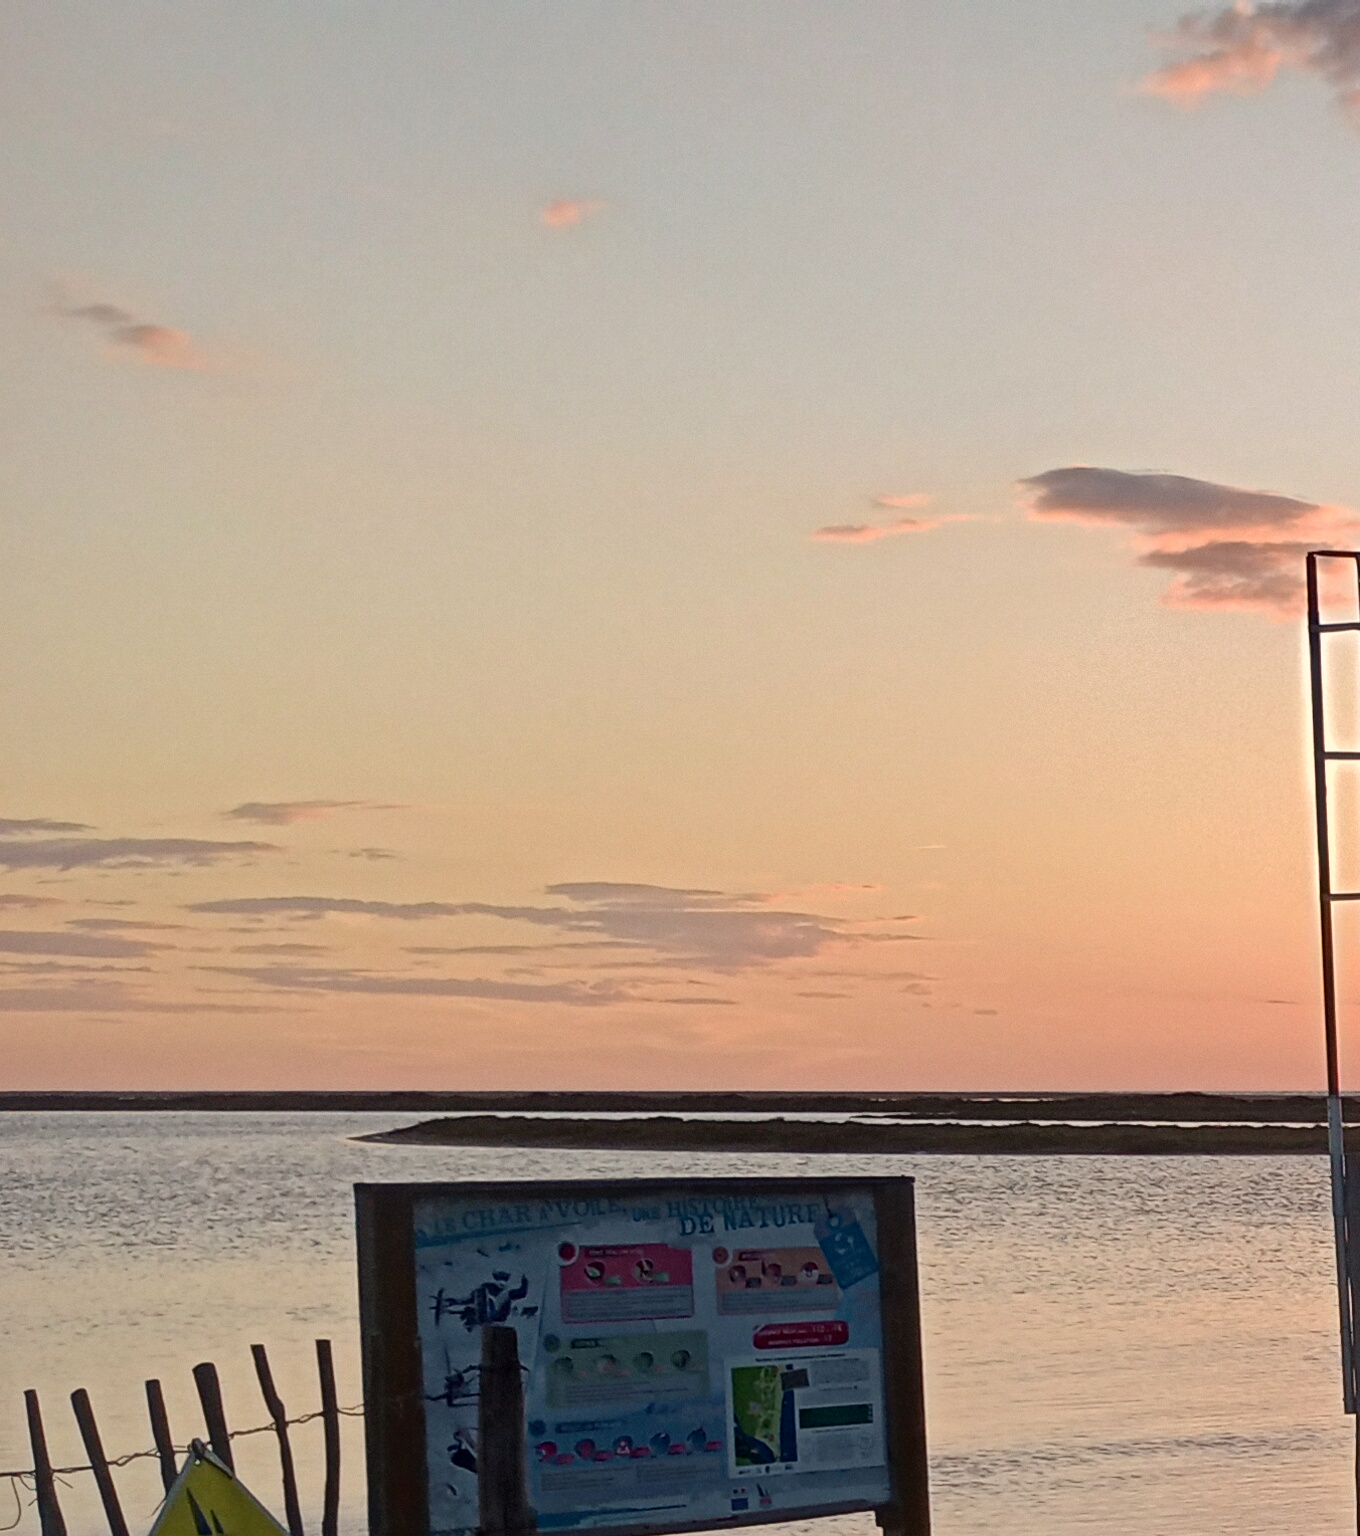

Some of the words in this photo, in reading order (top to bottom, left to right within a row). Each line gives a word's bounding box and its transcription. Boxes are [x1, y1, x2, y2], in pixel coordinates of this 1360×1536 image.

[463, 1205, 531, 1230] CHAR
[680, 1215, 714, 1236] DE
[723, 1203, 819, 1231] NATURE
